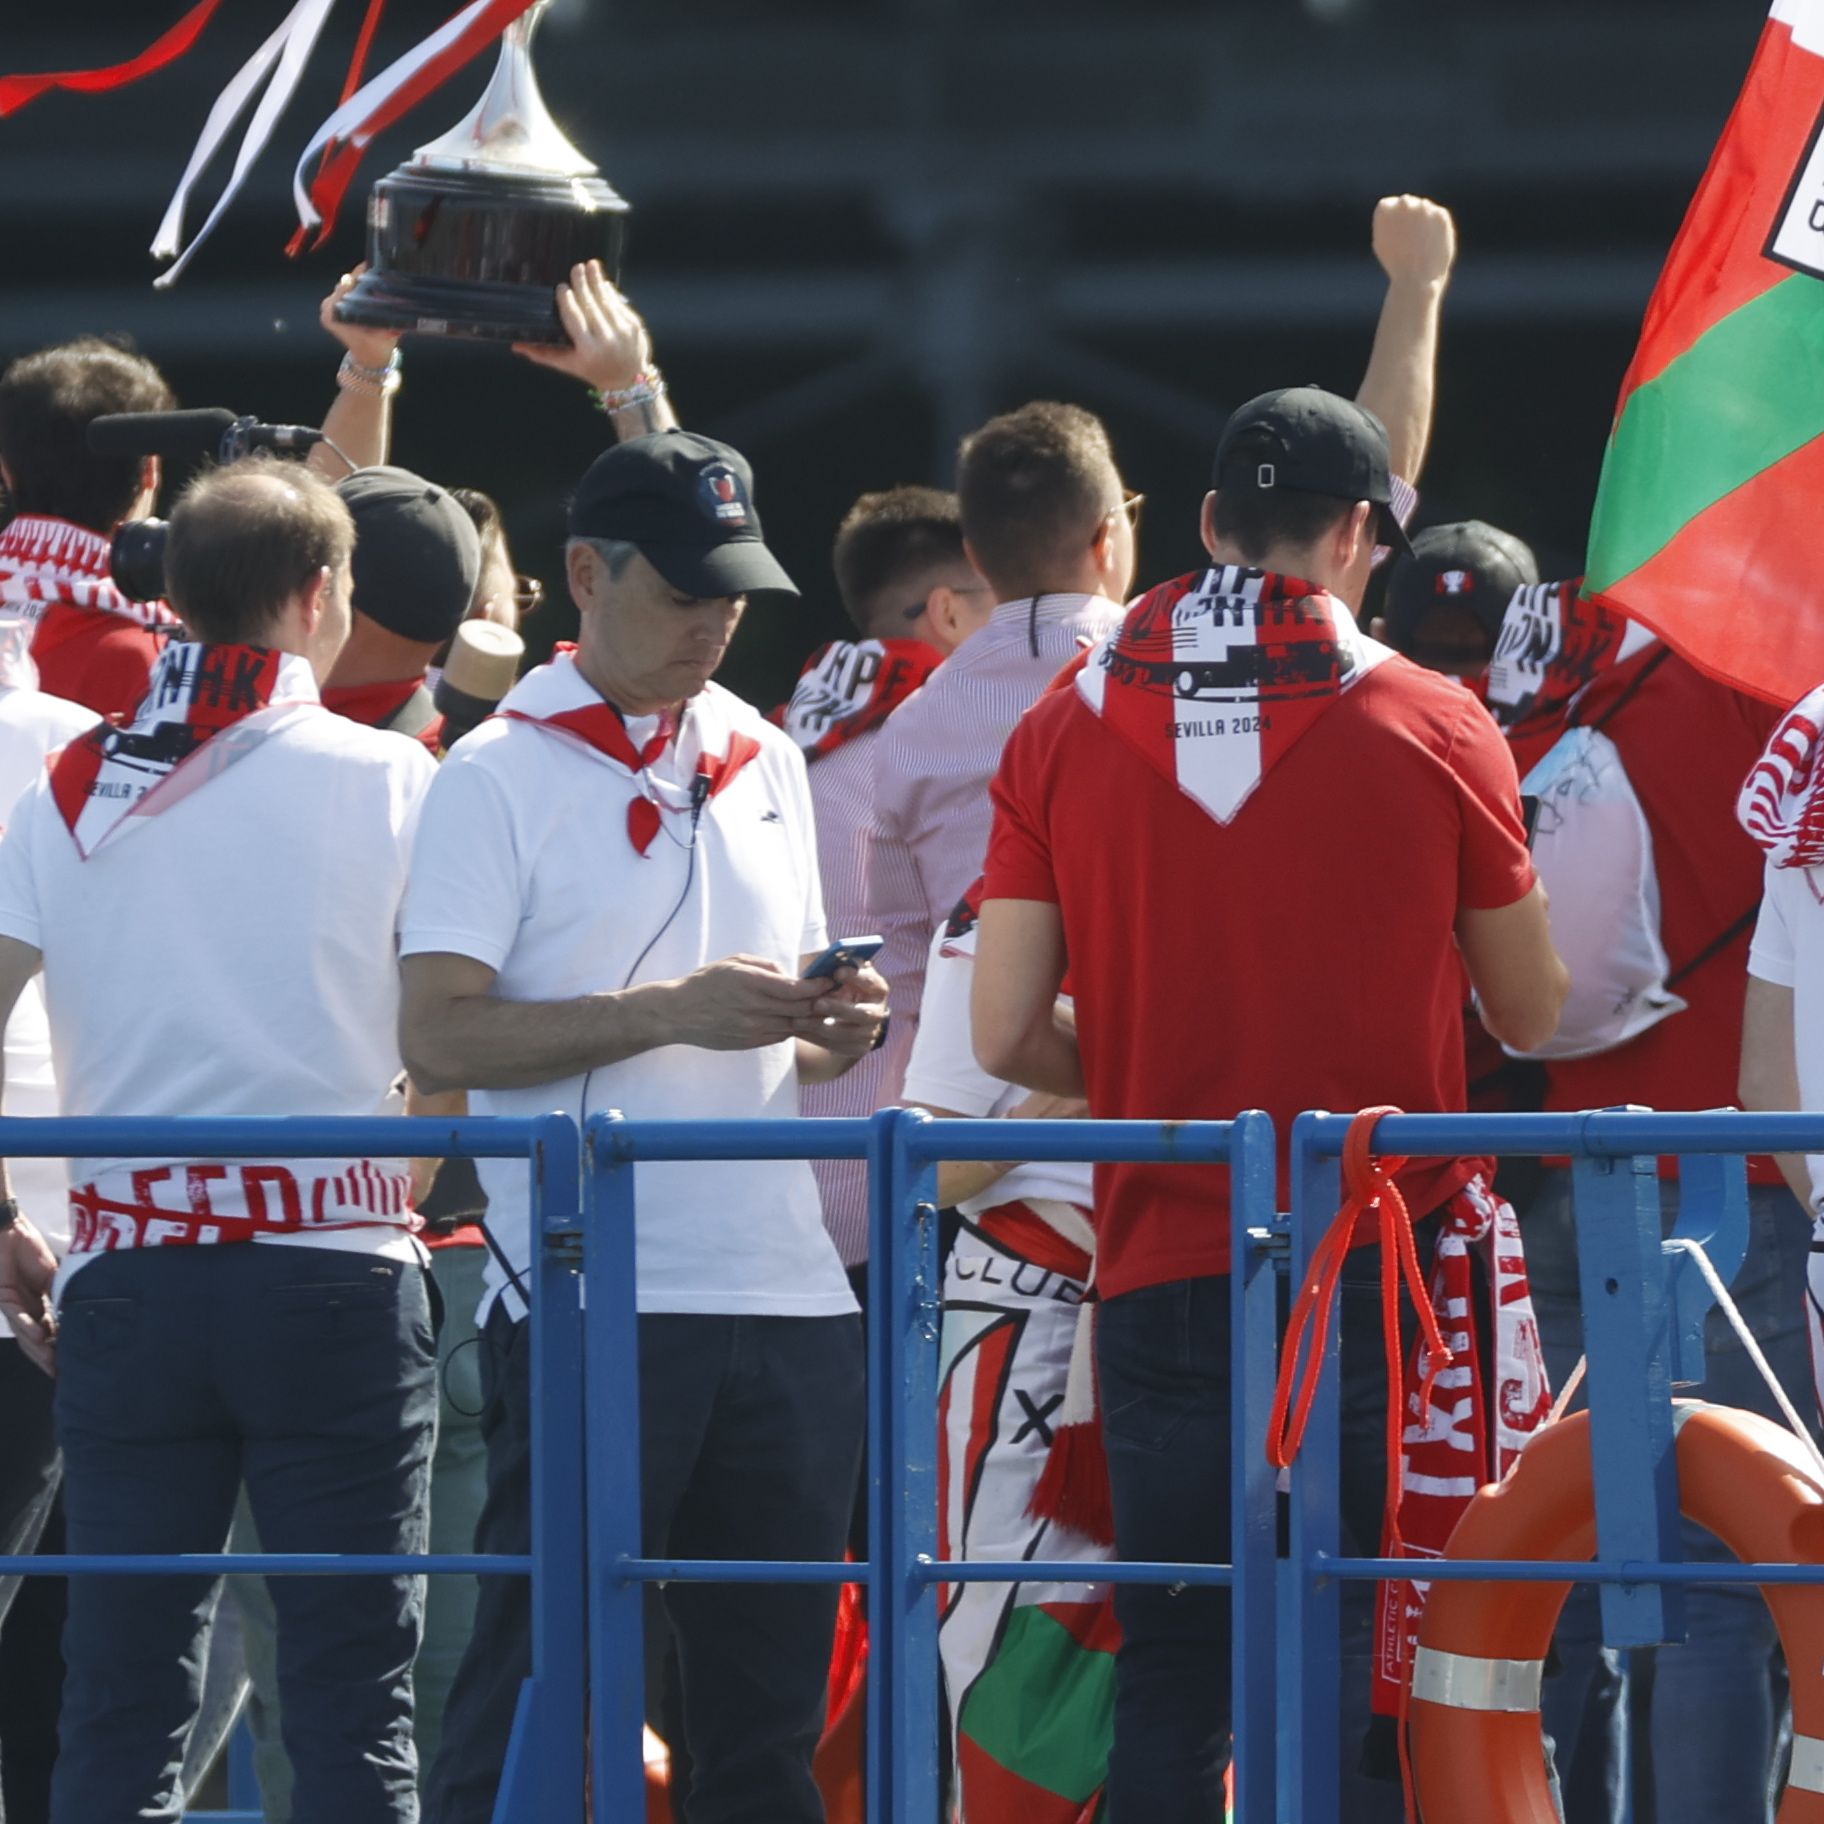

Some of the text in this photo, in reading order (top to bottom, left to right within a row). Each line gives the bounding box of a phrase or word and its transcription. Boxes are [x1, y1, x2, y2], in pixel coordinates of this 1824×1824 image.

[1166, 715, 1272, 738] SEVILLA 2024
[1385, 1599, 1400, 1673] ATHLETIC
